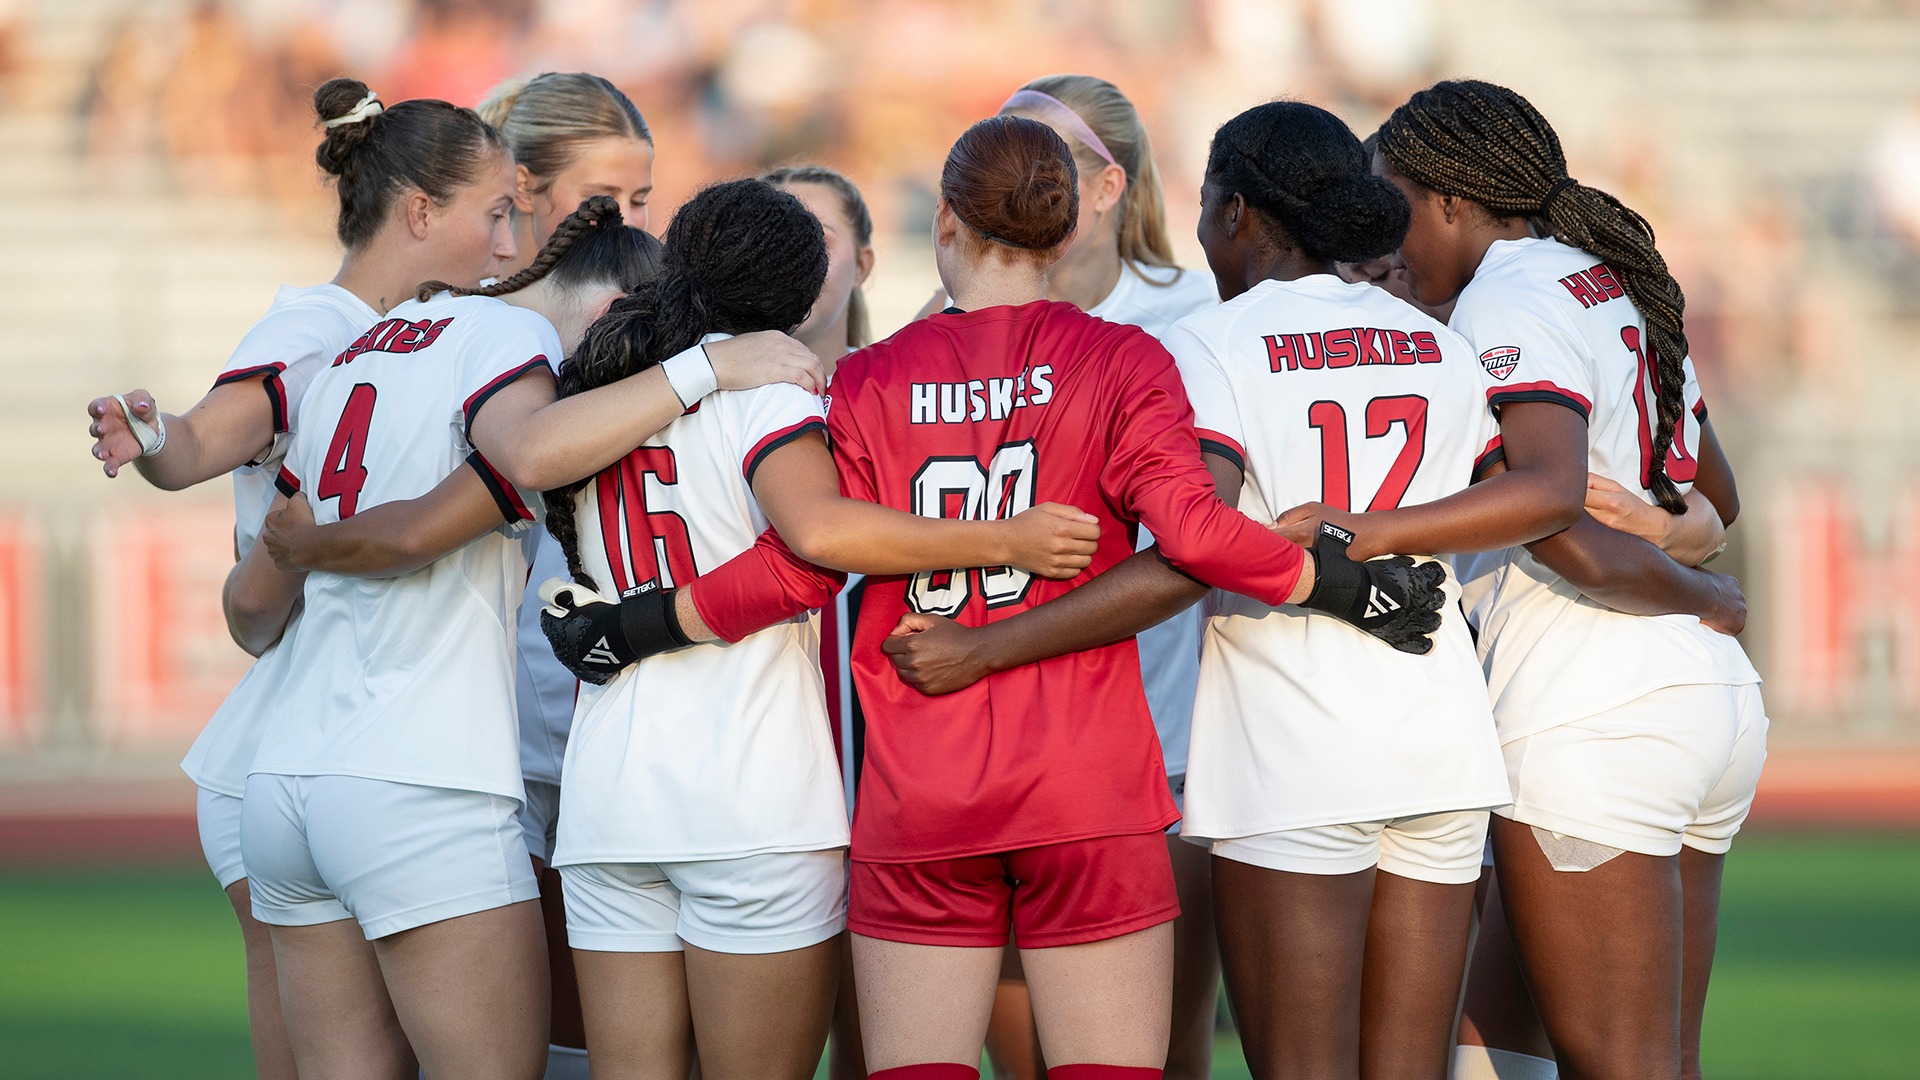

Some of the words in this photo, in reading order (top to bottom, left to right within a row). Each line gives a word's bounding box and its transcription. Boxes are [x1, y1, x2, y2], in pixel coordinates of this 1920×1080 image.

[1261, 327, 1442, 373] HUSKIES
[1482, 355, 1519, 370] MAC
[318, 382, 378, 521] 4
[1308, 394, 1429, 513] 12
[596, 446, 700, 598] 16
